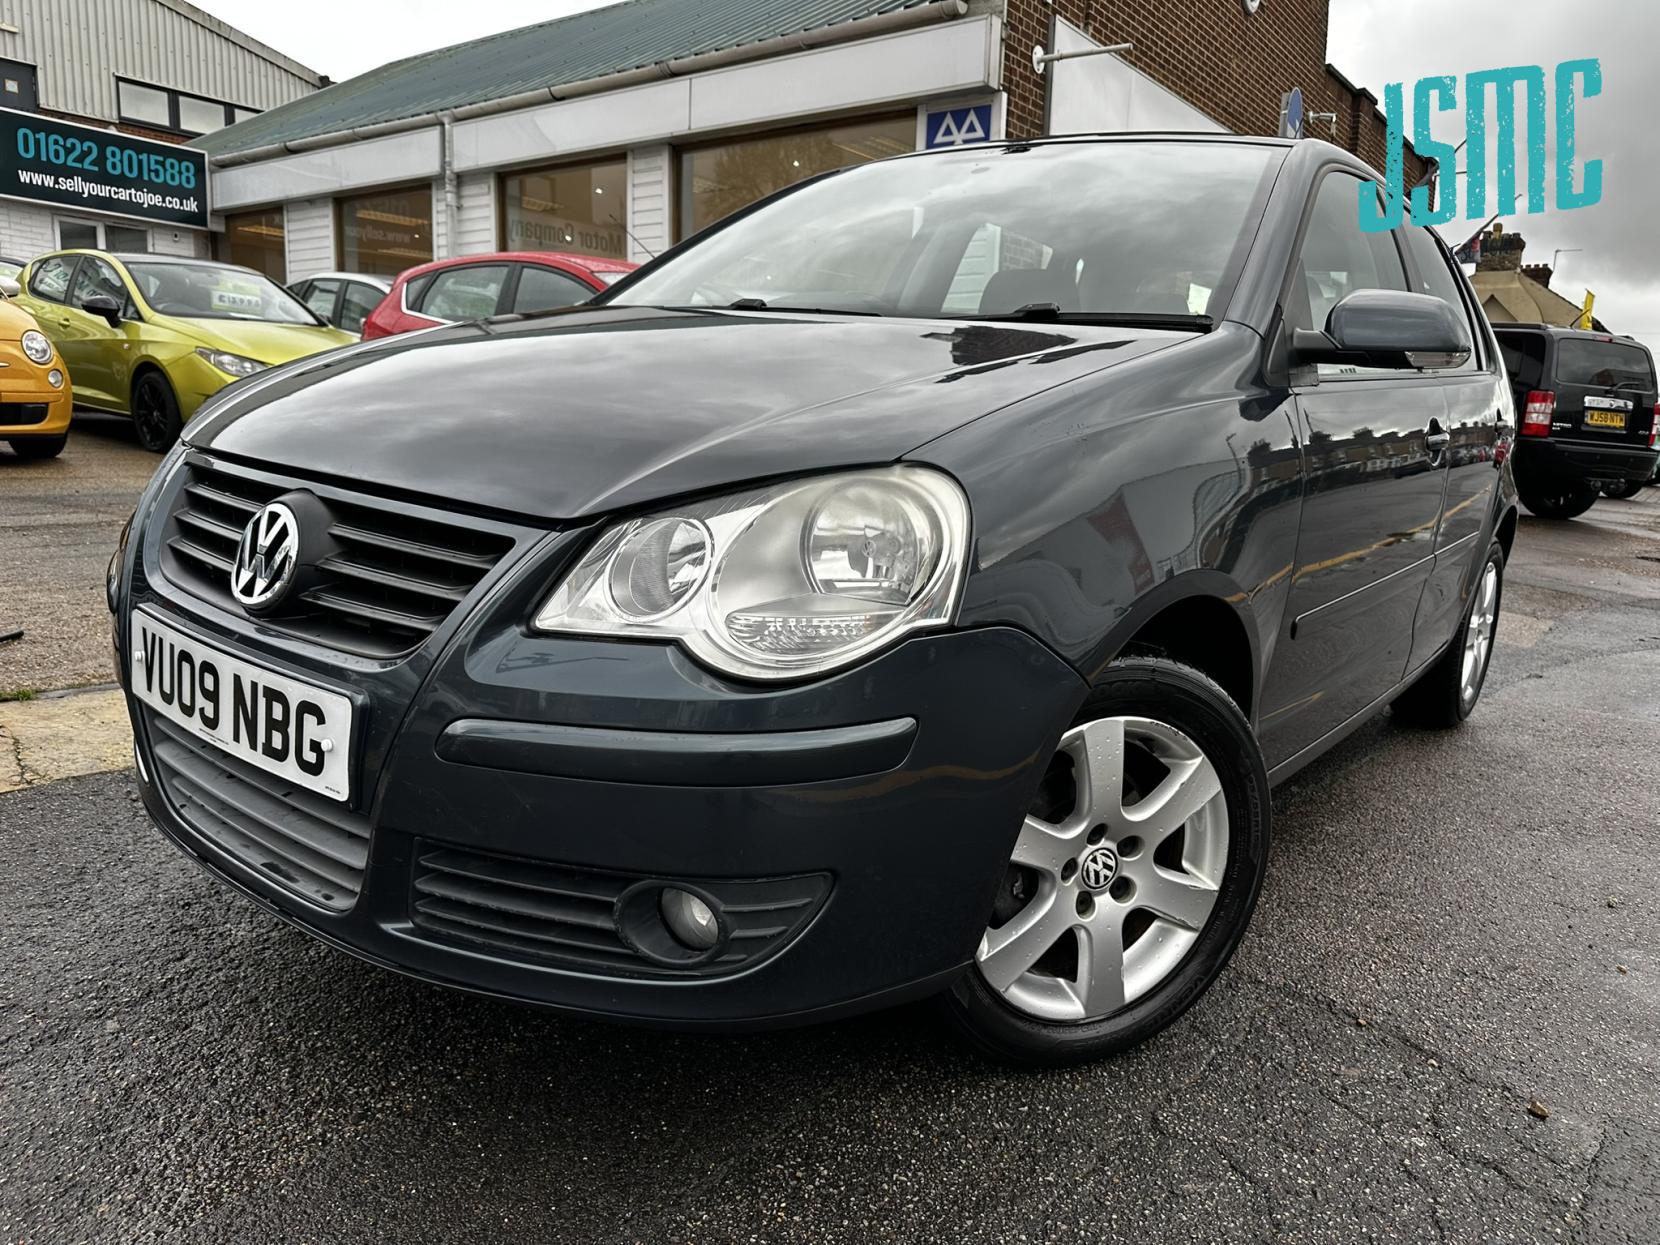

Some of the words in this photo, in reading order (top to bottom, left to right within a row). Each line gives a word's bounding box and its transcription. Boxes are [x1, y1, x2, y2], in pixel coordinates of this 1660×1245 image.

[17, 127, 99, 172] 01622
[106, 145, 196, 189] 801588
[17, 169, 199, 213] www.sellyourcartojoe.co.uk
[142, 626, 220, 731] VU09
[232, 672, 326, 777] NBG
